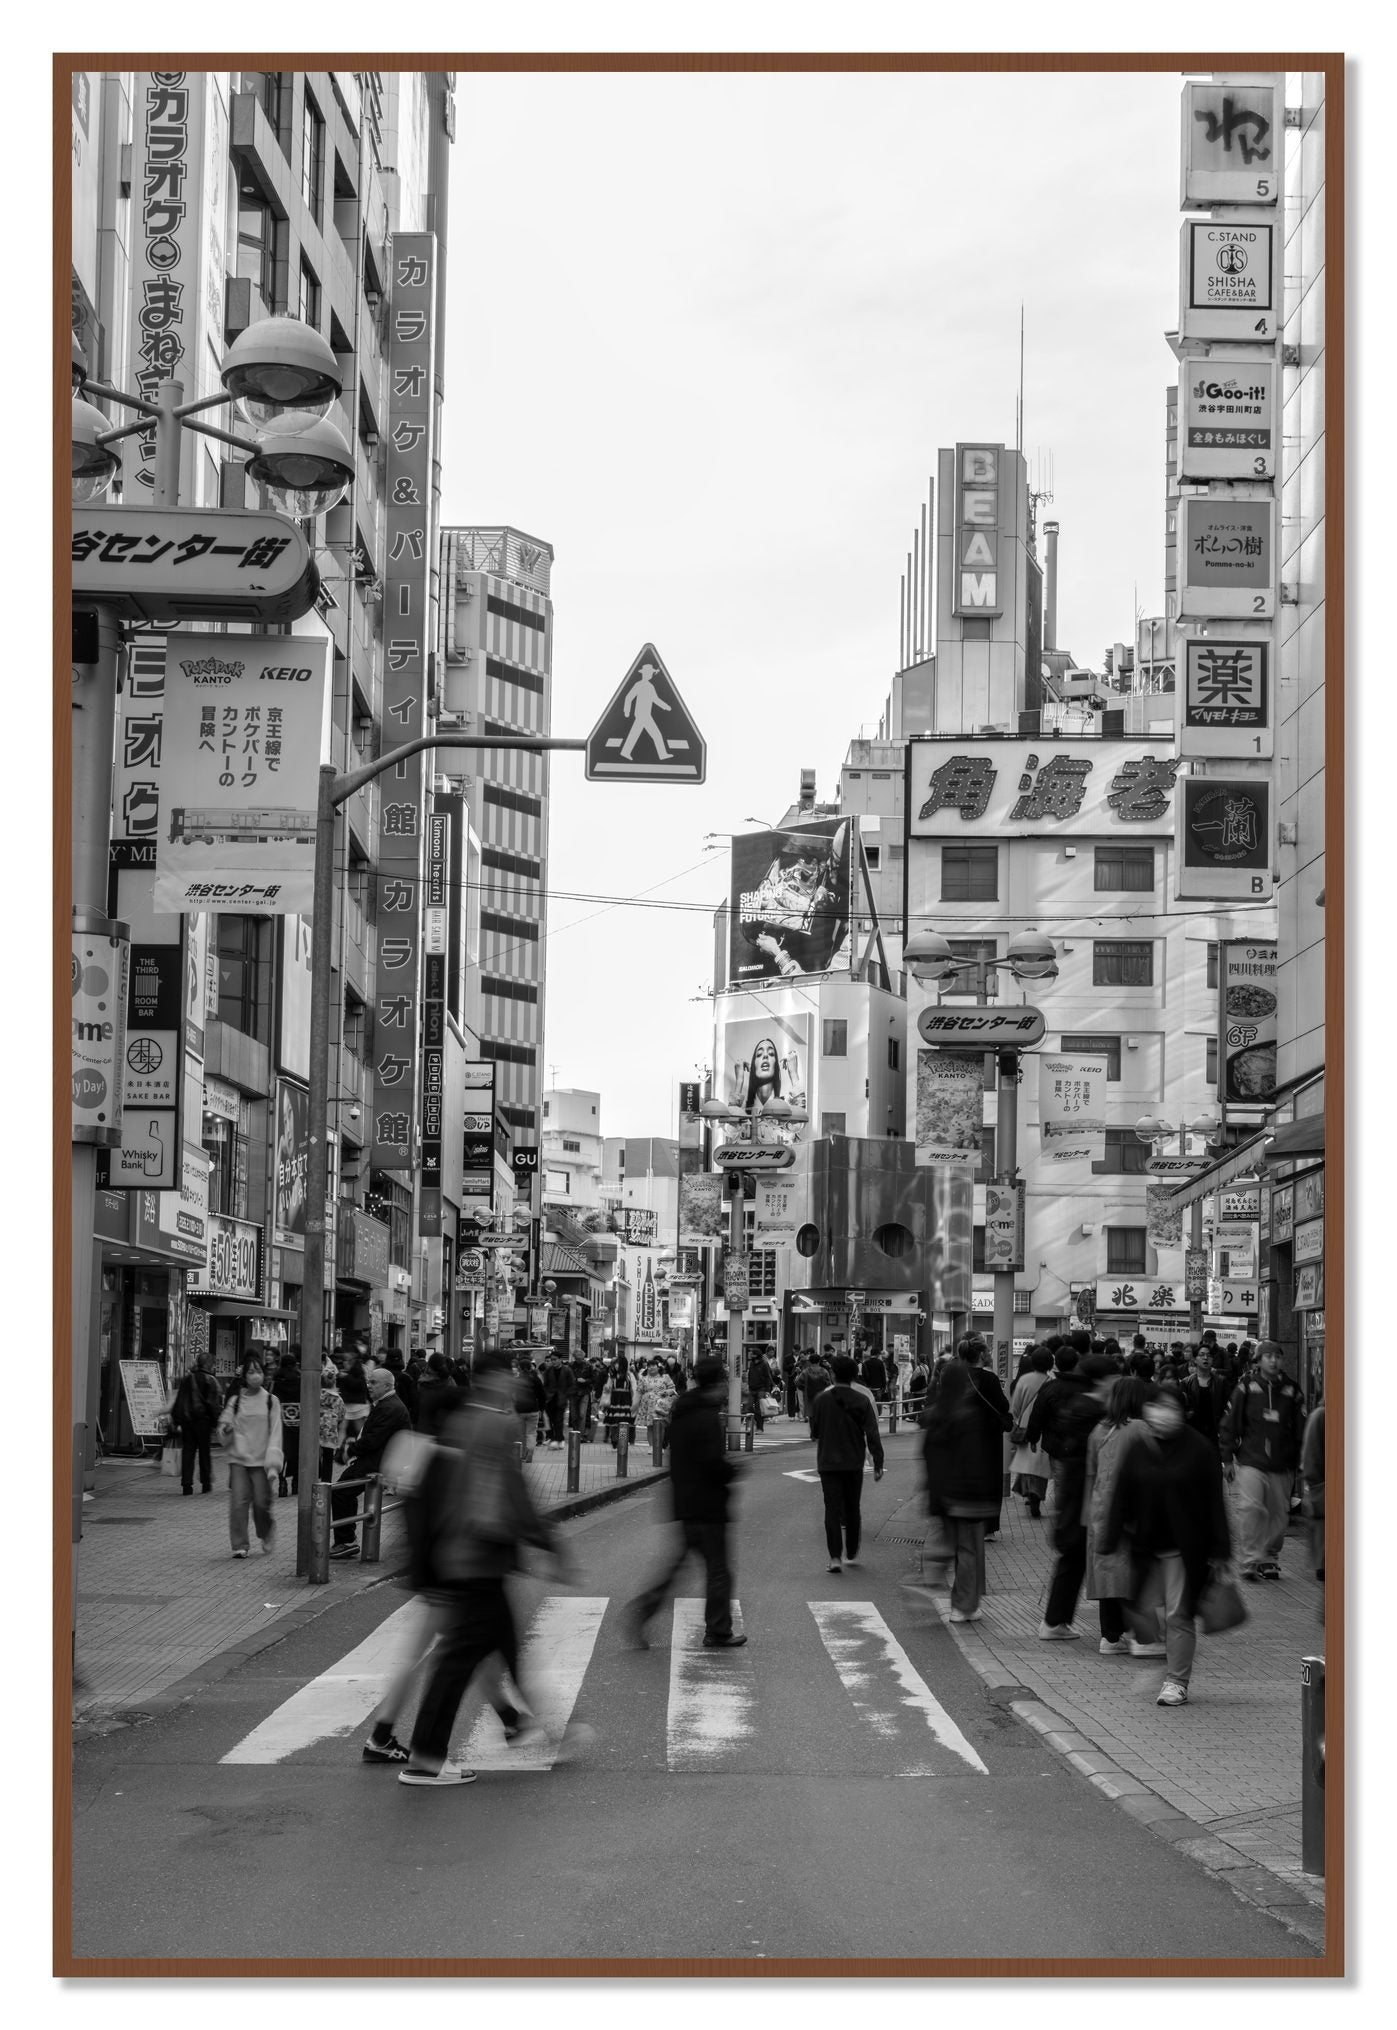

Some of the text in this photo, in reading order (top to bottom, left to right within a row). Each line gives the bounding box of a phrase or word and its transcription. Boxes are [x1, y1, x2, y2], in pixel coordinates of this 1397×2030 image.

[143, 87, 189, 238] カラオケ
[1256, 180, 1269, 197] 5
[1208, 232, 1257, 242] C.STAND
[1208, 276, 1257, 288] SHISHA
[1208, 289, 1257, 298] CAFE&BAR
[1206, 382, 1265, 400] Goo-it!
[1199, 404, 1262, 415] 渋谷宇田川町店
[1193, 432, 1267, 445] 全身もみほぐし
[1253, 457, 1267, 475] 3
[964, 449, 997, 607] BEAM
[1194, 535, 1264, 556] ポムの樹
[1205, 560, 1255, 568] Pomme-no-ki
[1253, 596, 1266, 613] 2
[194, 675, 232, 684] KANTO
[259, 666, 313, 682] KEIO
[1198, 649, 1253, 705] 薬
[1191, 708, 1259, 723] マツモトキヨシ
[199, 706, 217, 752] 冒険へ
[218, 706, 239, 787] カントーの
[241, 706, 262, 787] ポケパーク
[265, 706, 284, 773] 京王線で
[1252, 736, 1262, 753] 1
[918, 755, 1179, 821] 角海老
[433, 819, 441, 858] kimono
[185, 884, 282, 899] 渋谷センター街
[1251, 876, 1264, 894] B
[432, 925, 442, 944] SALON
[135, 966, 160, 974] THIRD
[140, 958, 155, 966] THE
[738, 964, 764, 972] SALOMON
[1229, 963, 1277, 977] 四川料理
[135, 997, 158, 1005] ROOM
[138, 1009, 154, 1017] BAR
[925, 1015, 1037, 1032] 渋谷センター街
[1226, 1026, 1258, 1048] 6F
[1080, 1066, 1102, 1074] KEIO
[83, 1079, 105, 1095] Day!
[127, 1092, 149, 1100] SAKE
[1063, 1081, 1071, 1112] カントーの
[477, 1121, 491, 1130] UP
[122, 1149, 158, 1162] Whisky
[515, 1153, 537, 1165] GU
[717, 1150, 786, 1160] 渋谷センター街
[121, 1160, 143, 1169] Bank
[1112, 1283, 1176, 1308] 兆楽
[644, 1282, 654, 1328] BEER
